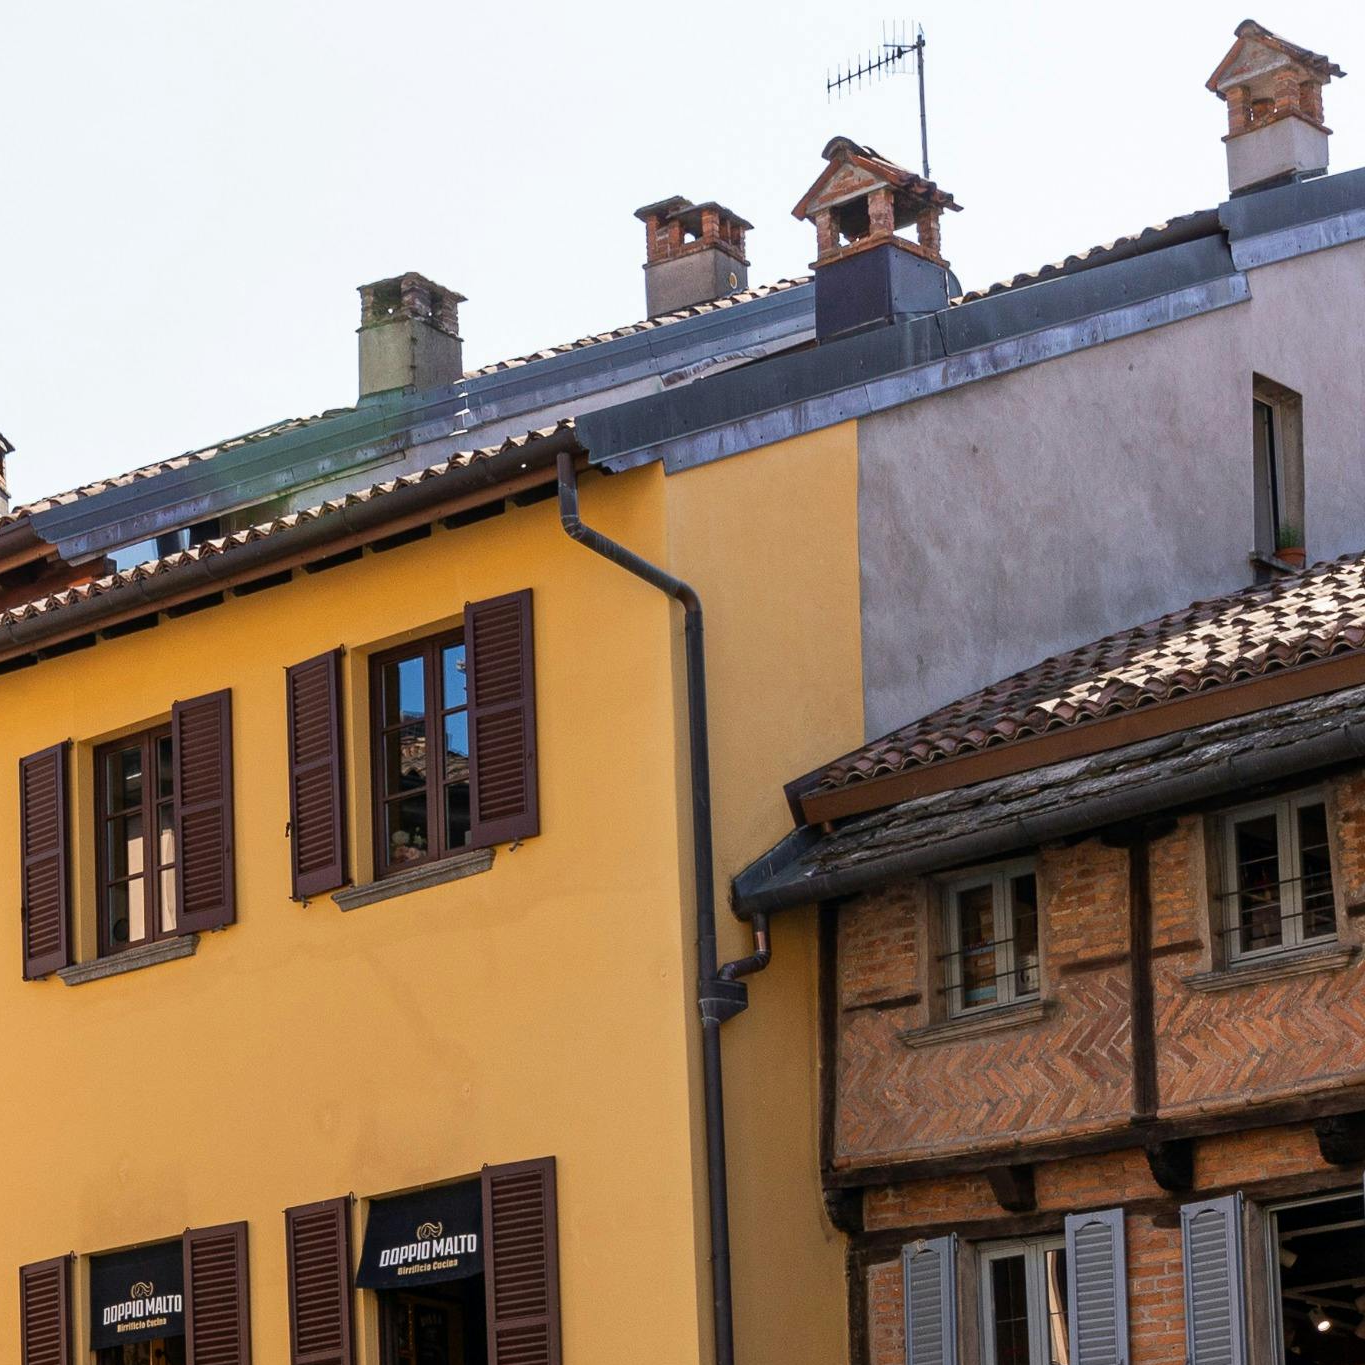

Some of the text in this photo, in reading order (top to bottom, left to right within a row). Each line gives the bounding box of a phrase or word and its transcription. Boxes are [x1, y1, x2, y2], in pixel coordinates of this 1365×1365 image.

[379, 1233, 477, 1268] DOPPIO MALTO
[103, 1294, 182, 1326] DOPPIO MALTO
